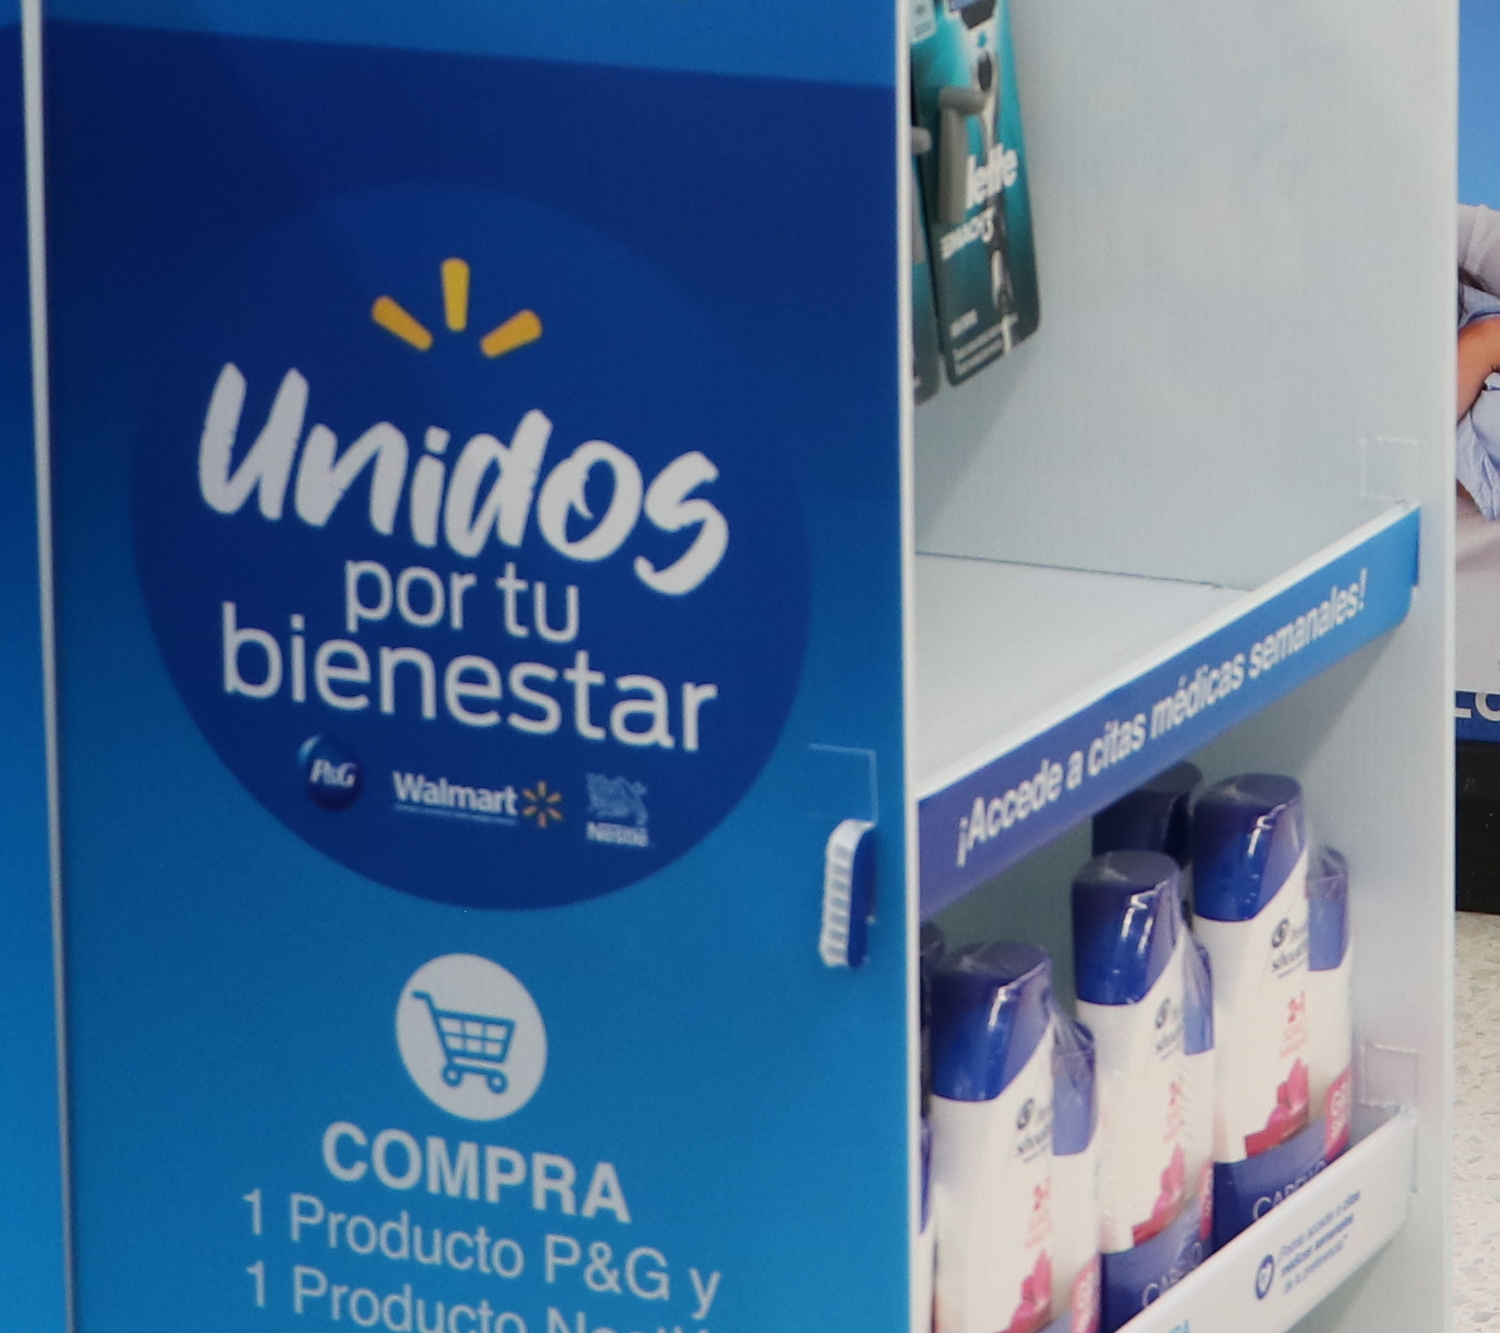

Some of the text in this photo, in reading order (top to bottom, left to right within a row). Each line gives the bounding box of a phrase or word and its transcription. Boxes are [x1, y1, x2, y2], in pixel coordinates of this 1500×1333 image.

[197, 361, 729, 595] Unidos
[222, 599, 718, 753] bienestar
[345, 558, 580, 642] por tu
